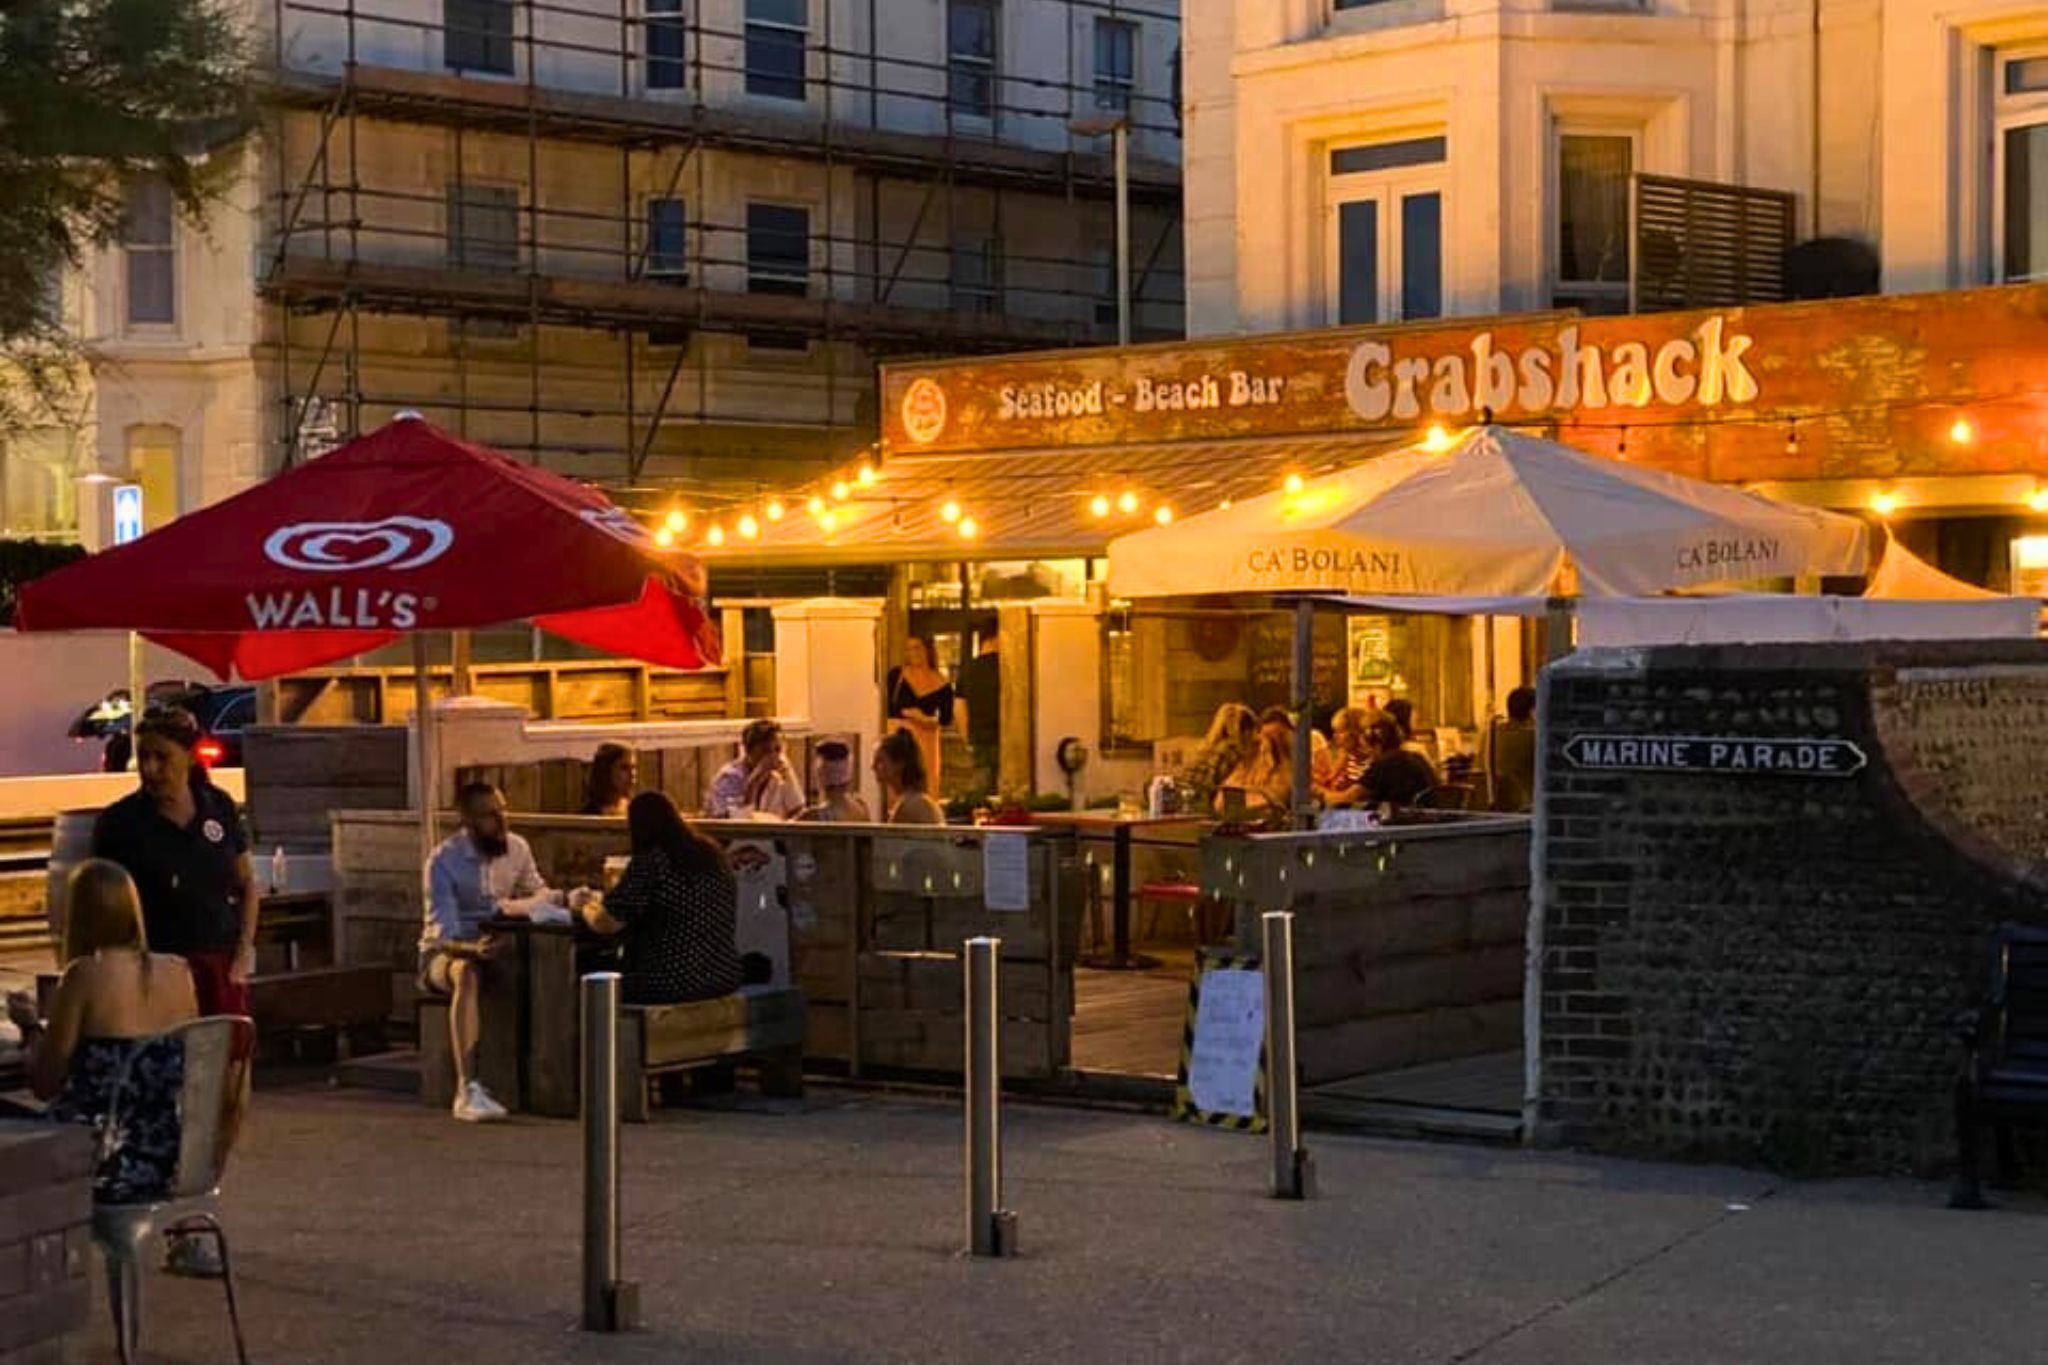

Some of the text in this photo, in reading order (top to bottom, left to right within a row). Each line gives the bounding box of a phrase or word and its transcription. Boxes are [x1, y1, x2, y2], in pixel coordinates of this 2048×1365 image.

[1345, 315, 1759, 421] Crabshack
[999, 380, 1102, 420] Seafood
[1134, 375, 1220, 412] Beach
[1229, 371, 1284, 405] Bar
[245, 584, 418, 630] WALL'S
[1582, 741, 1839, 770] MARINE PARADE
